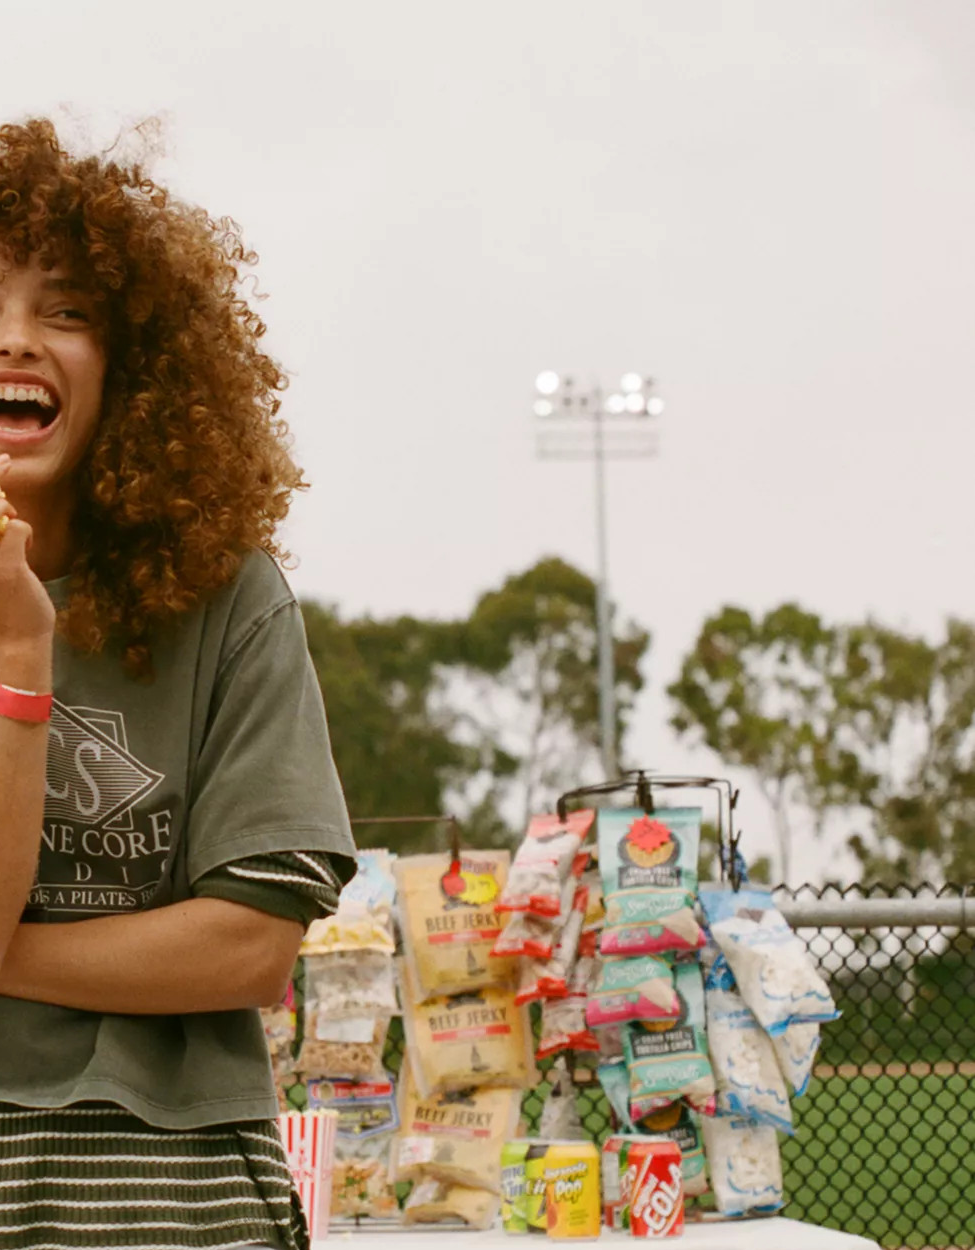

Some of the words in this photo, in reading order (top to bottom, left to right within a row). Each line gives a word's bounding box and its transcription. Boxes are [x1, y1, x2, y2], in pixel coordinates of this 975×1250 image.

[81, 809, 173, 860] CORE
[53, 891, 65, 904] A
[71, 890, 137, 907] PILATES
[425, 915, 456, 932] BEEF
[463, 911, 502, 929] JERKY
[428, 1012, 459, 1032] BEEF
[467, 1006, 507, 1027] JERKY
[415, 1105, 446, 1123] BEEF
[451, 1110, 494, 1128] JERKY
